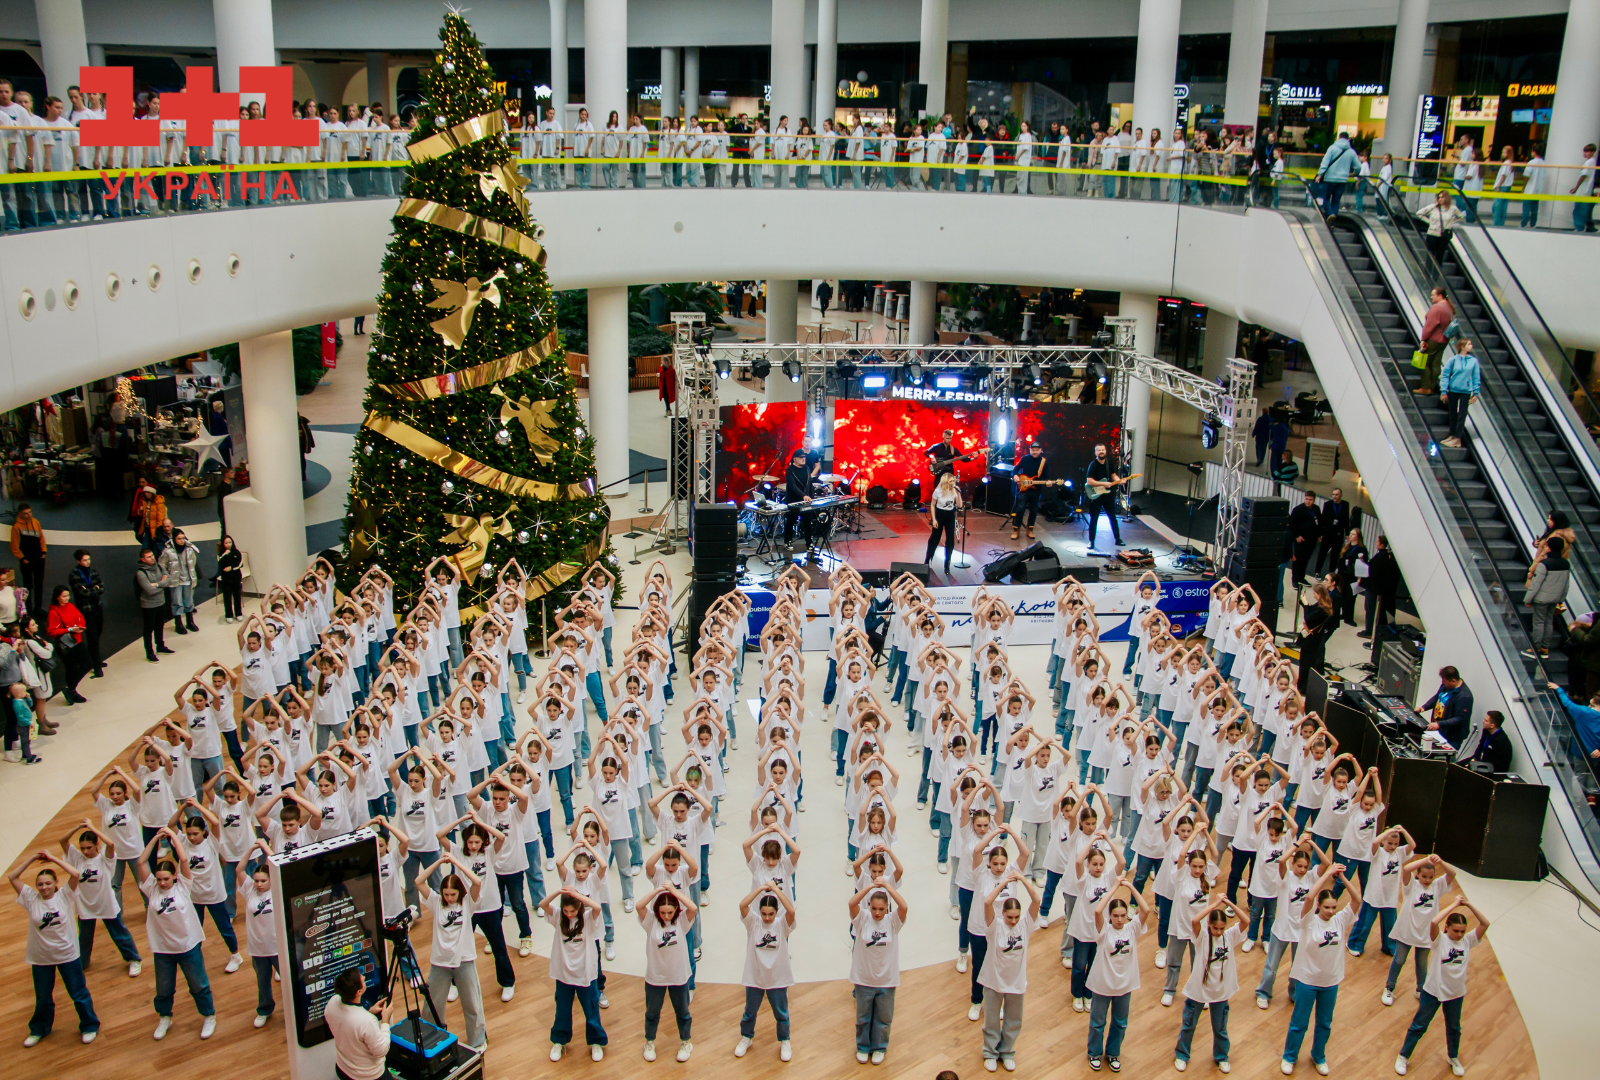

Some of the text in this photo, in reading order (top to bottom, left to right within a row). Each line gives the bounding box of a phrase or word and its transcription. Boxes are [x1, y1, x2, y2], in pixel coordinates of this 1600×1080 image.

[1290, 86, 1322, 98] GRILL
[1520, 84, 1556, 97] ЮДЖИ
[1424, 97, 1433, 110] 3
[892, 386, 941, 401] MERRY
[1185, 588, 1210, 597] estro
